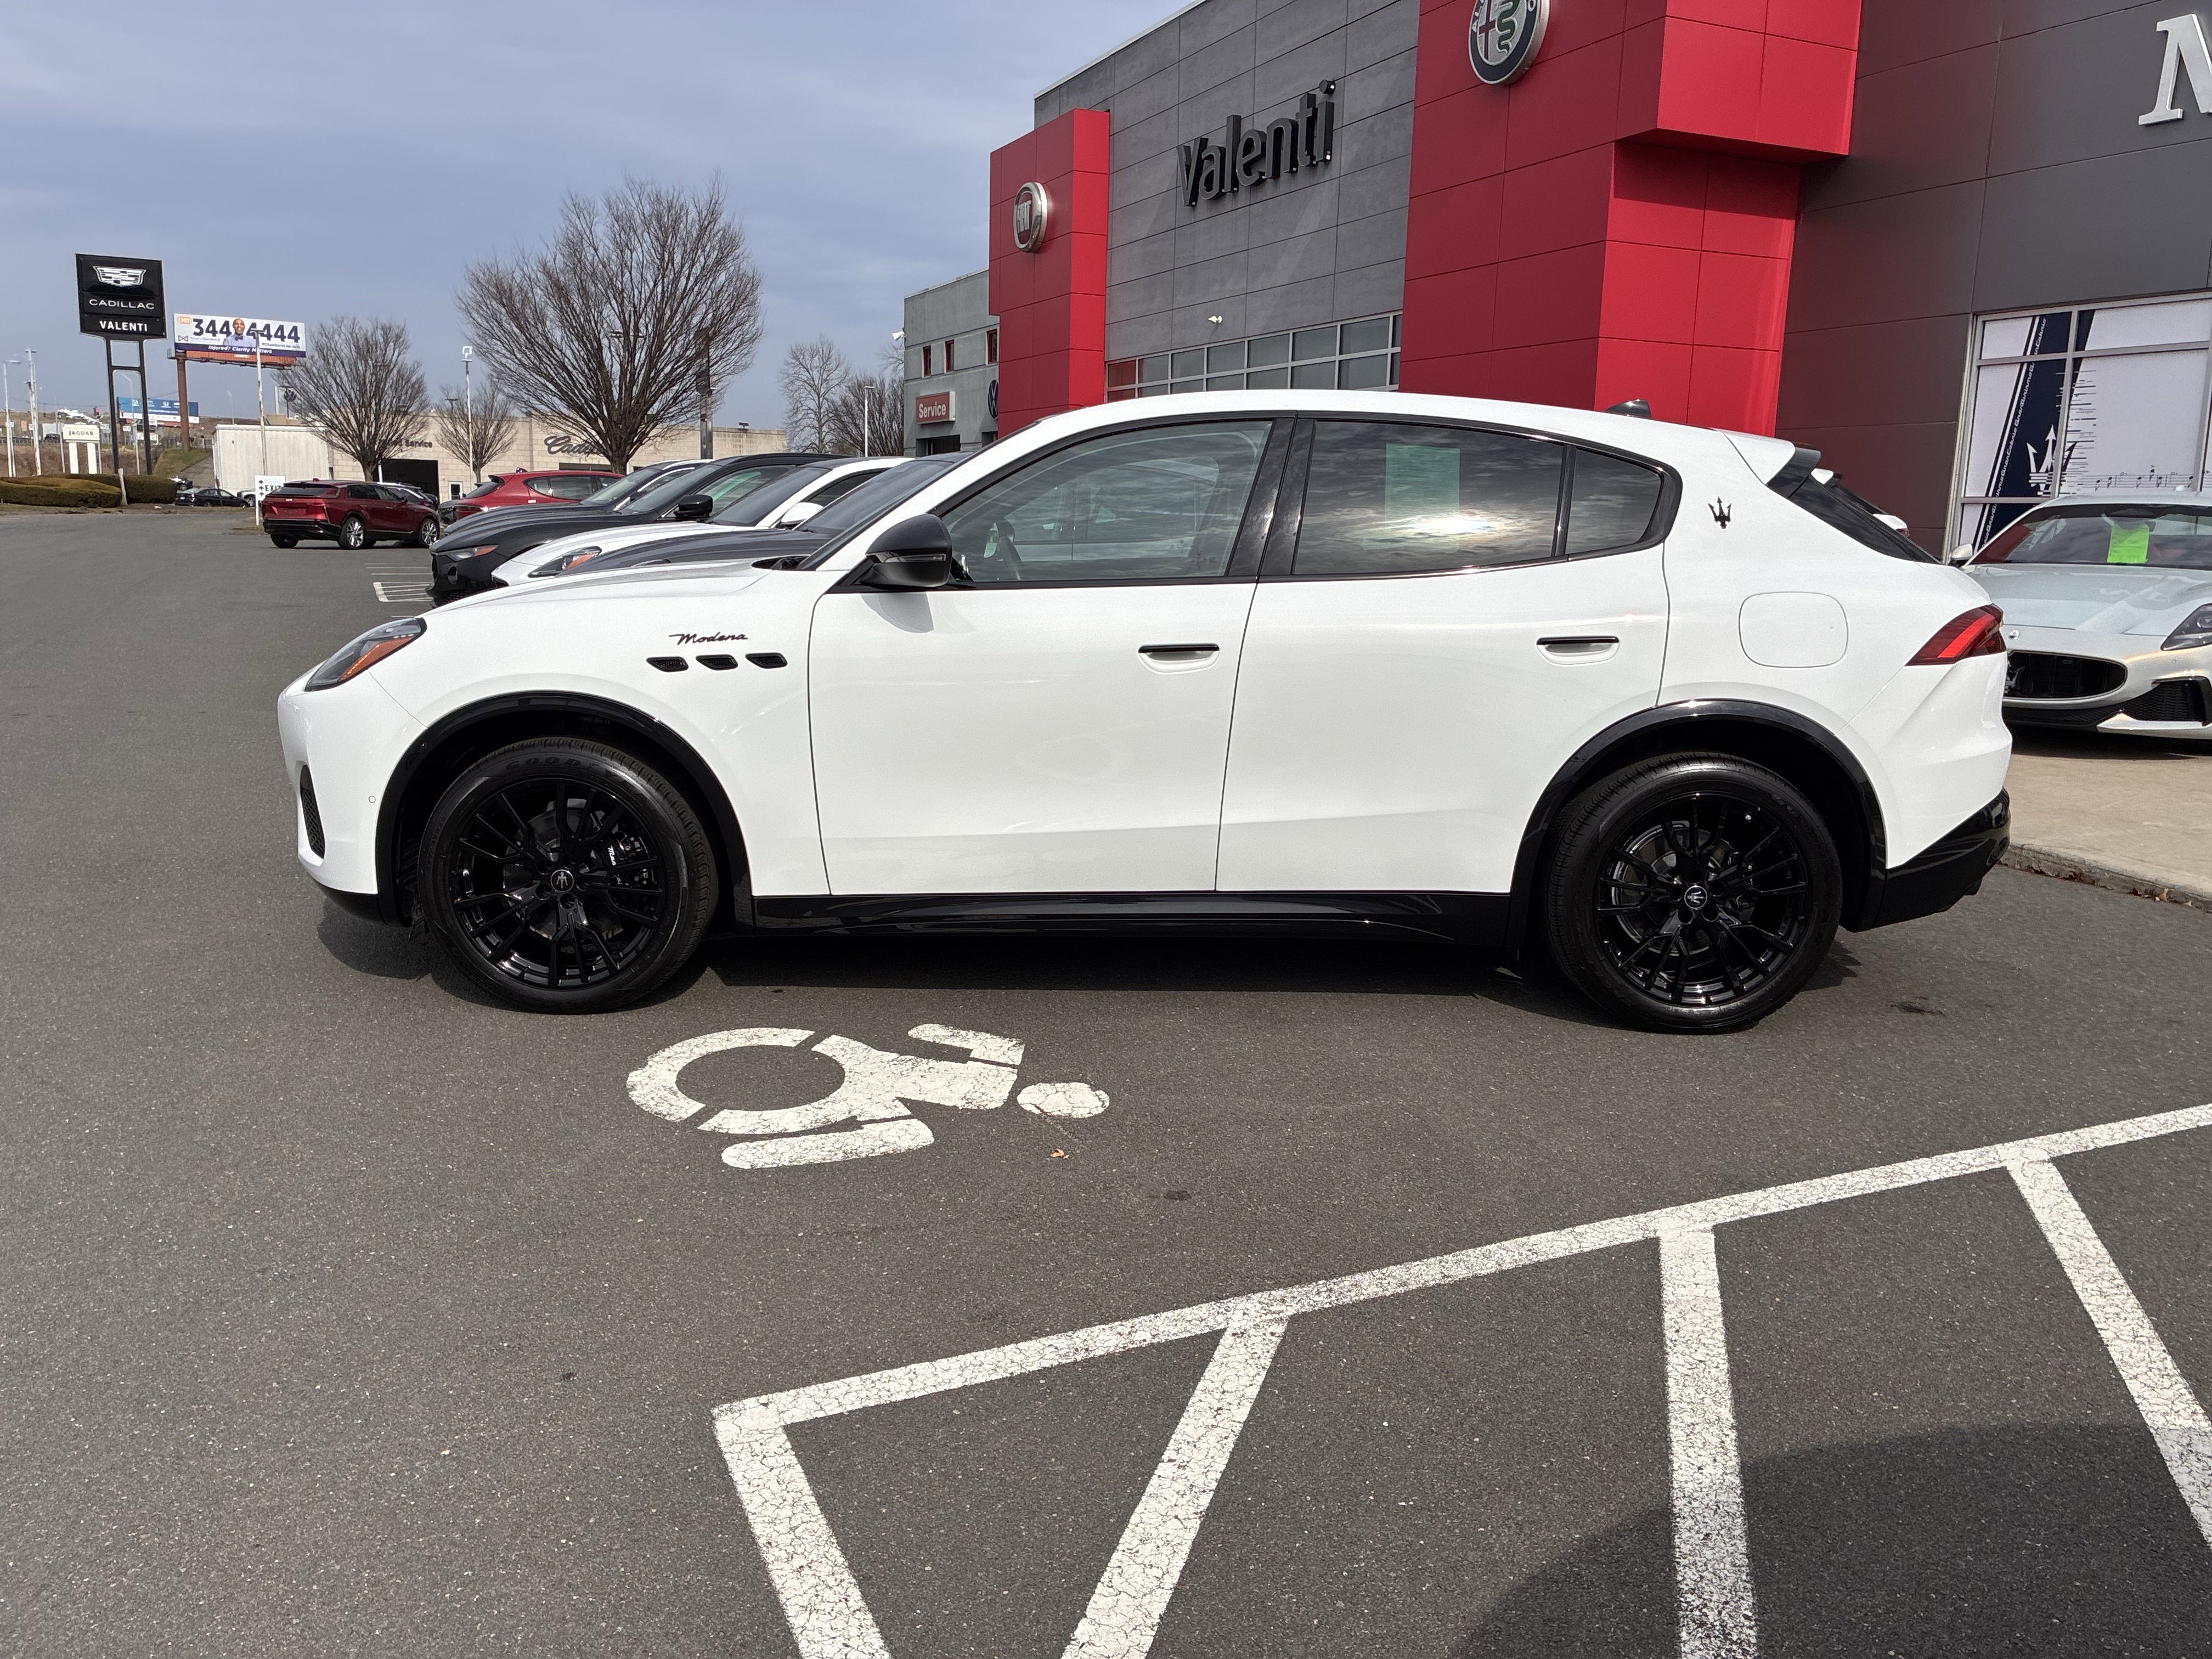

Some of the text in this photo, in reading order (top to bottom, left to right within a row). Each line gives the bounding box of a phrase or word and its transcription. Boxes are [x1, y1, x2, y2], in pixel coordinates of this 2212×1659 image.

[1176, 80, 1336, 206] Valenti
[89, 299, 155, 310] CADILLAC
[99, 320, 148, 332] VALENTI
[193, 318, 232, 337] 344
[246, 322, 300, 343] 4444
[918, 401, 946, 419] Service
[669, 631, 748, 645] Modena
